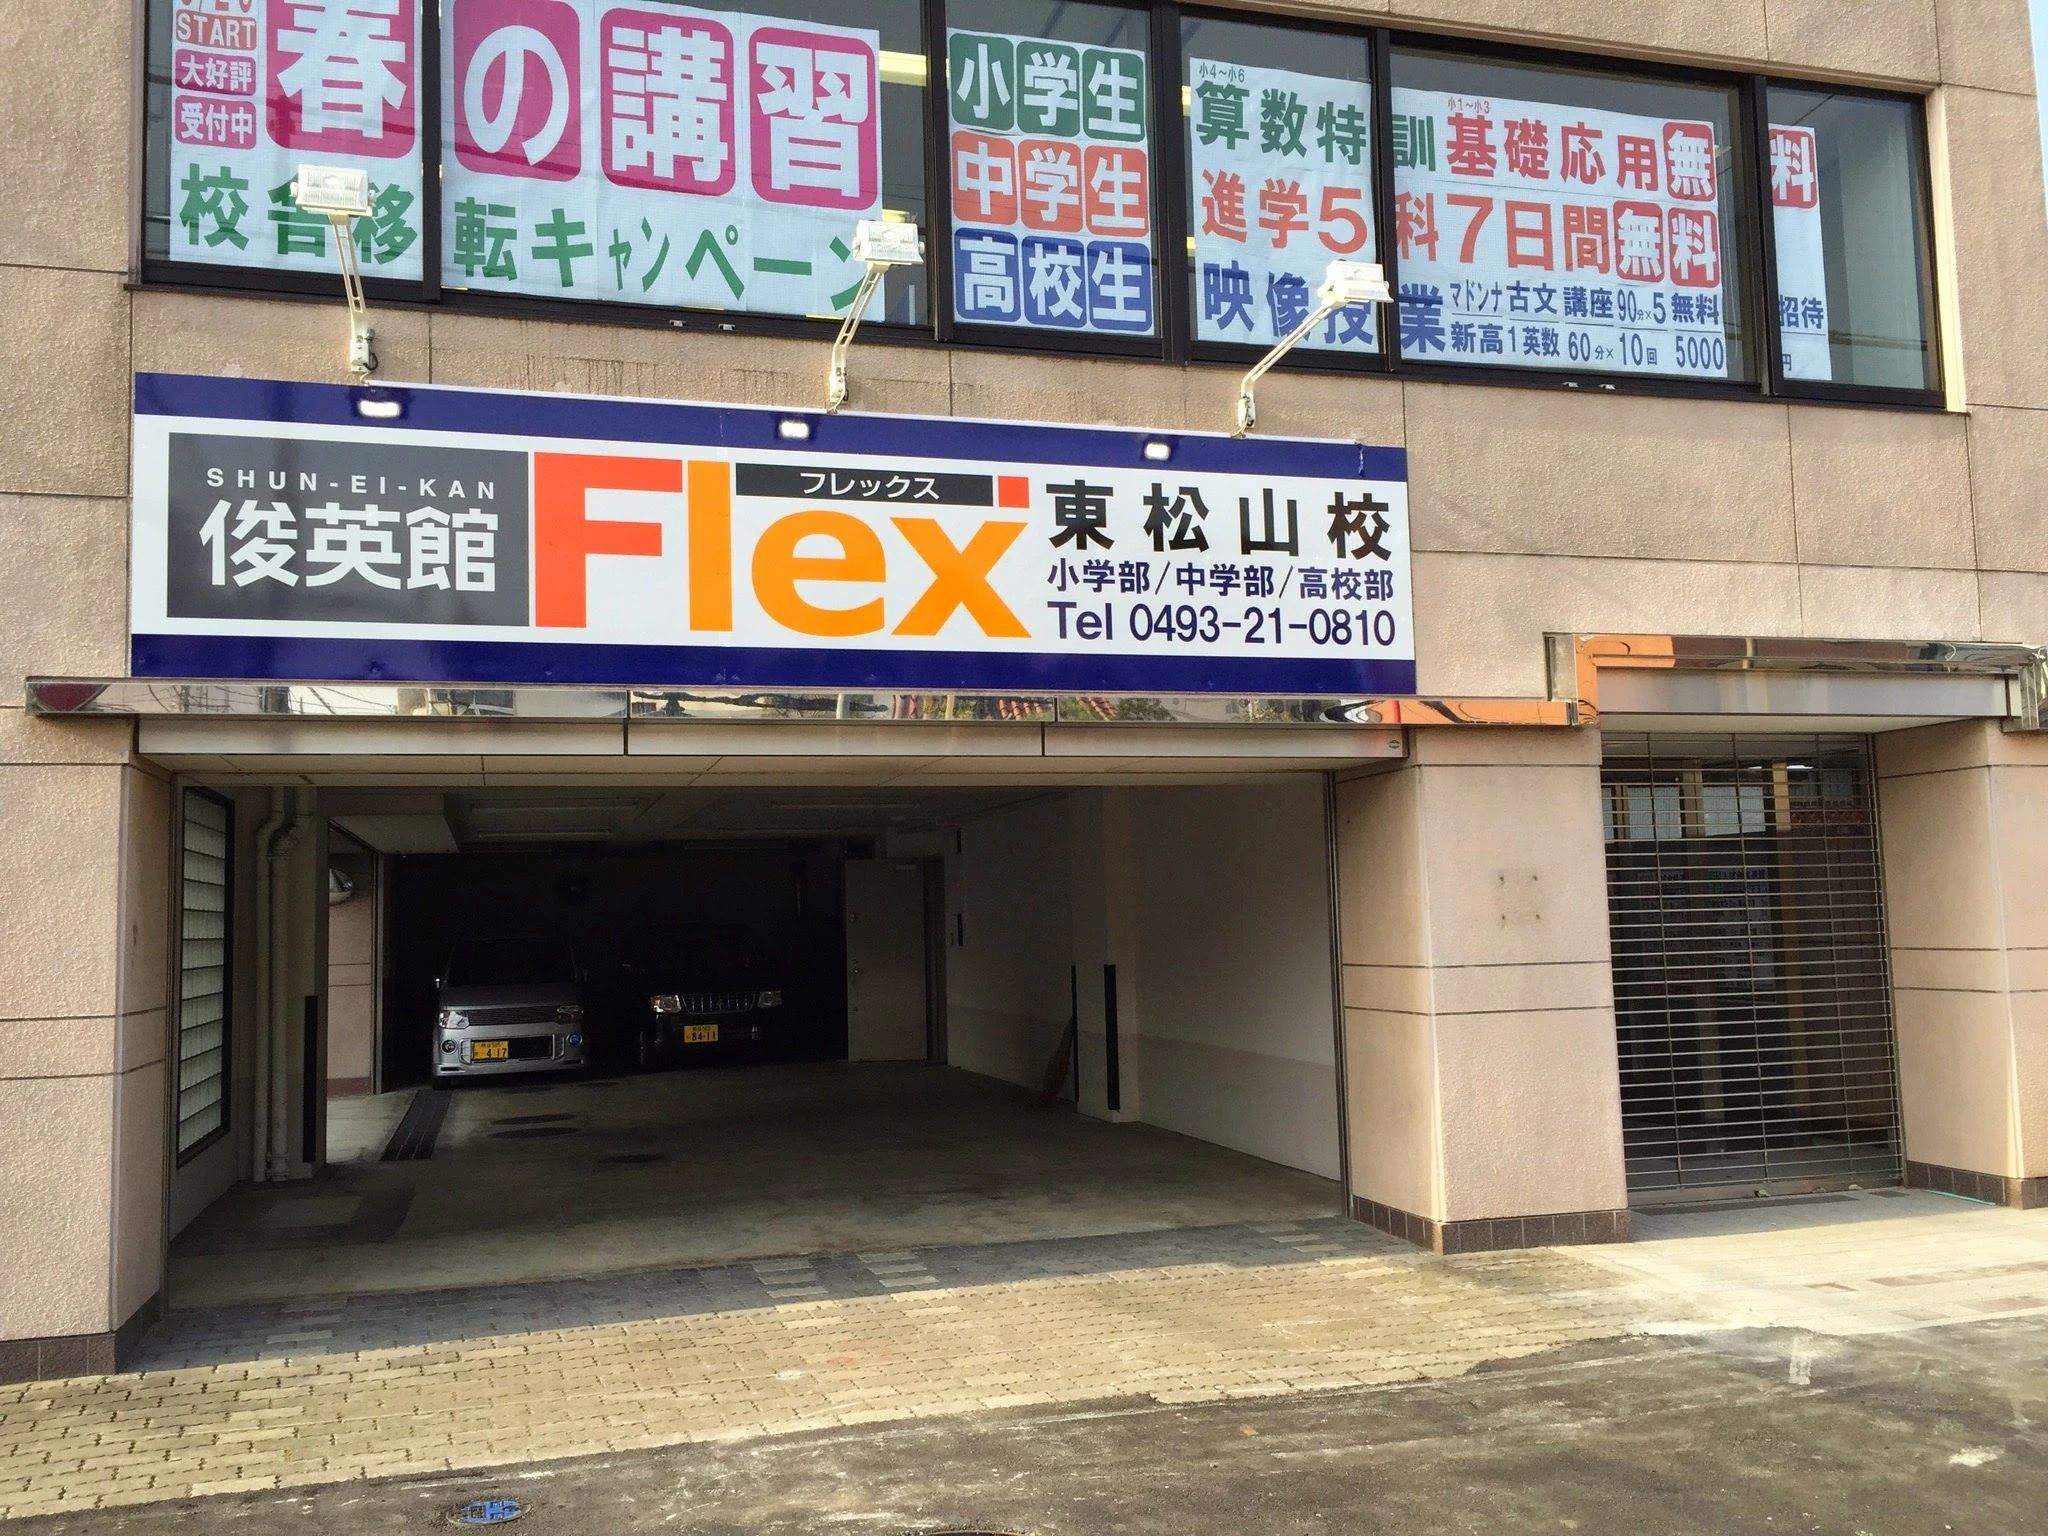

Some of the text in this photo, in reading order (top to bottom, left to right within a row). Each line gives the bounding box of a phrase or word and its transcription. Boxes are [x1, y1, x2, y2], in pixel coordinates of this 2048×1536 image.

[177, 12, 255, 48] START
[181, 54, 252, 92] 大好評
[957, 43, 1142, 136] 小学生
[180, 102, 253, 144] 受付中
[957, 143, 1147, 231] 中学生
[960, 236, 1152, 322] 高校生
[206, 467, 495, 500] SHUN-EI-KAN
[800, 472, 940, 500] フレックス
[199, 499, 499, 592] 俊英館
[534, 452, 1031, 638] Flex
[1046, 480, 1393, 561] 東松山校
[1047, 600, 1396, 647] Tel 0493-21-0810
